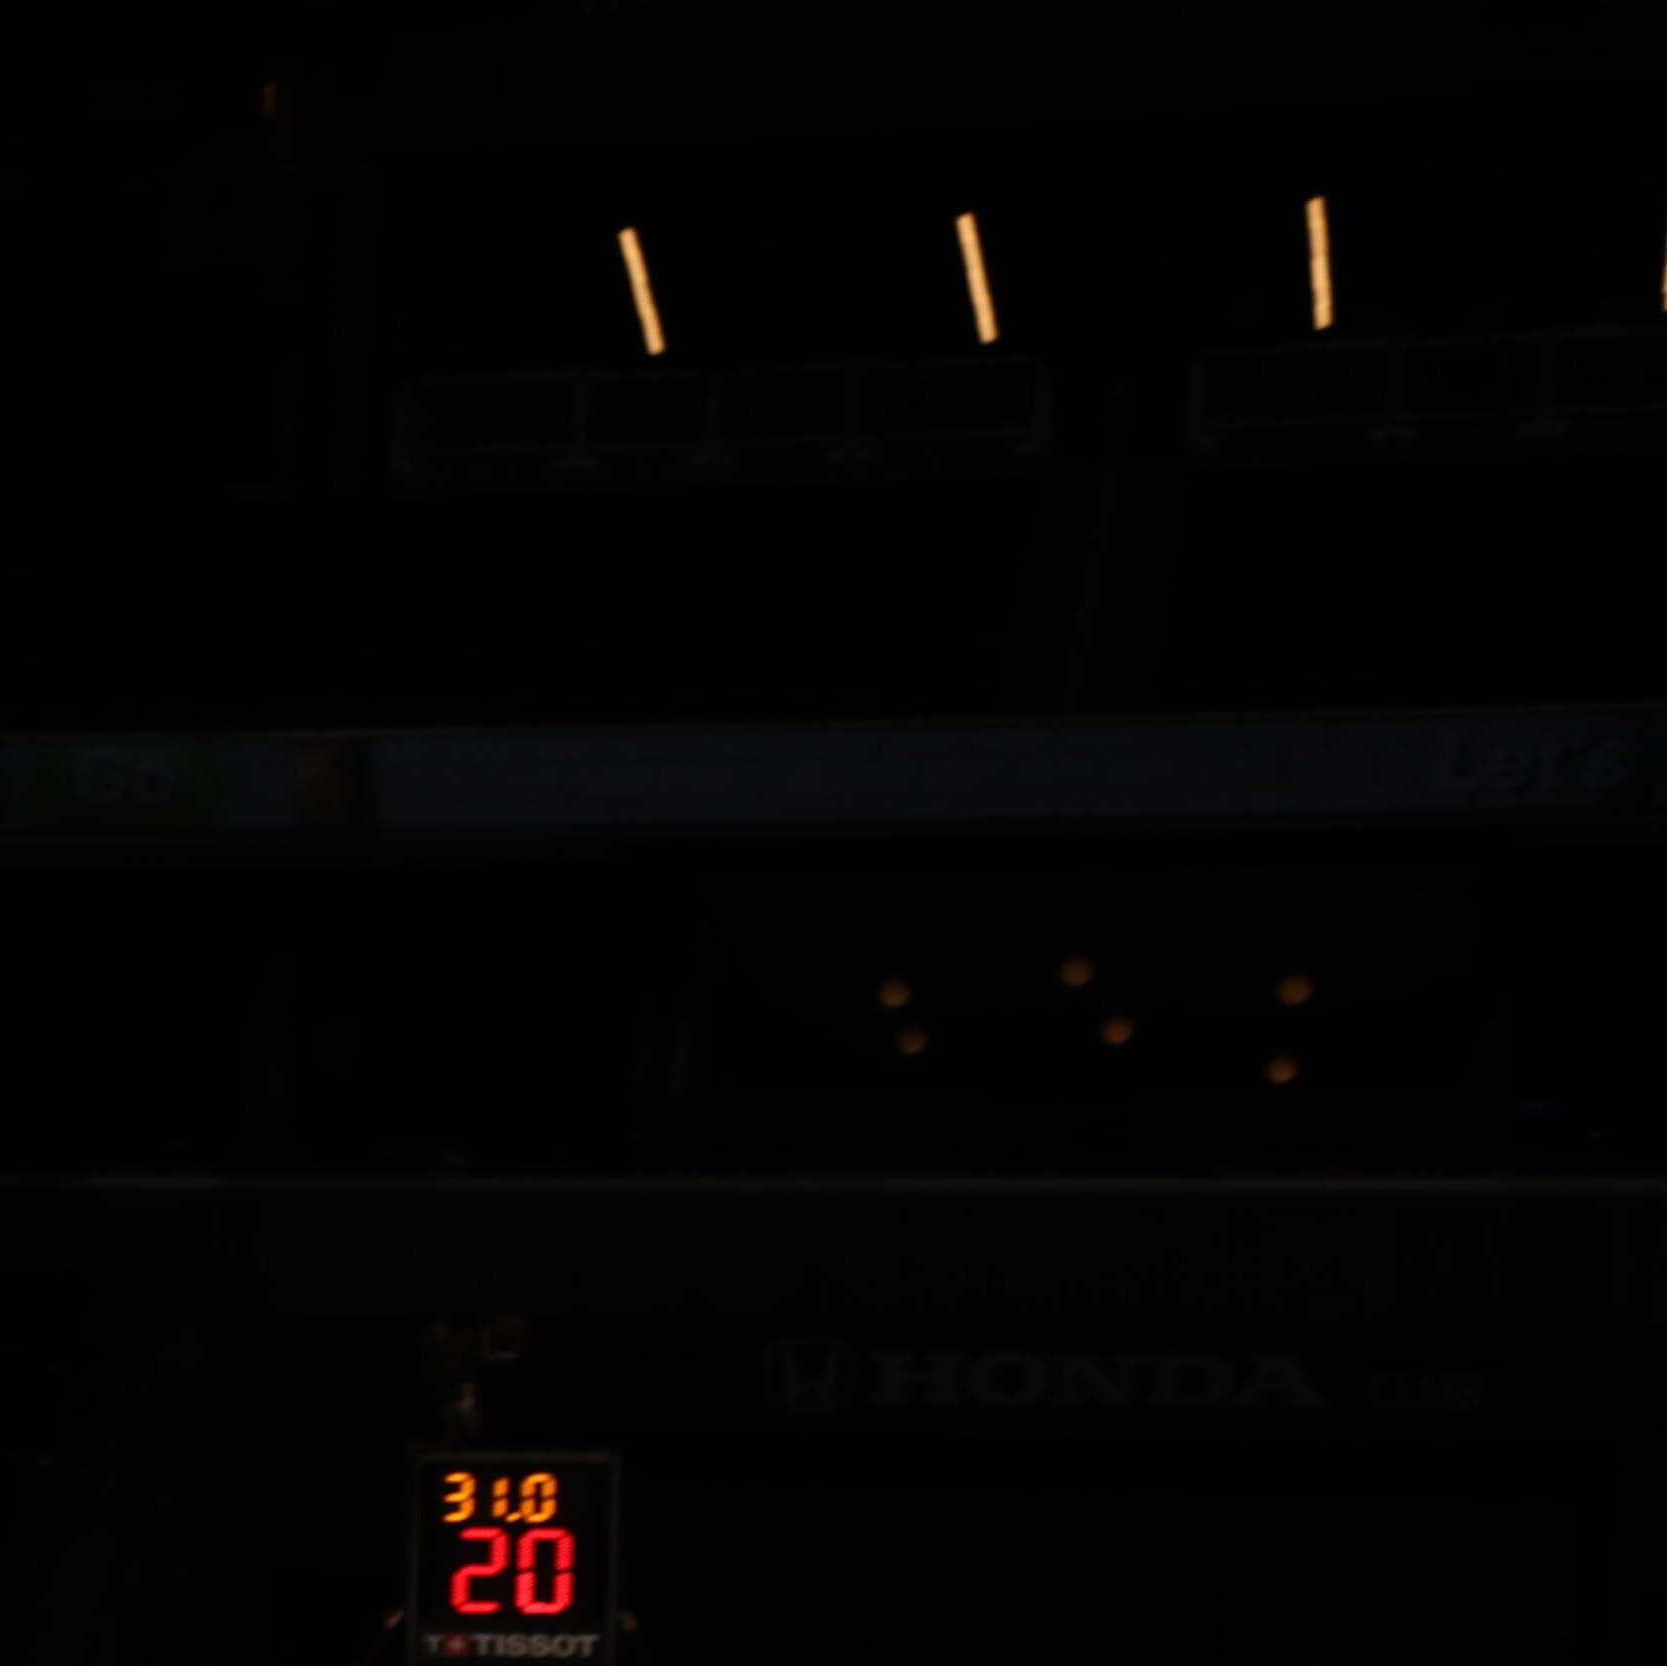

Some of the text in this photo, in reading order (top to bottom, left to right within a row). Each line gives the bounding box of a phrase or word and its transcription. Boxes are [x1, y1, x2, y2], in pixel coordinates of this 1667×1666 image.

[870, 1349, 1331, 1407] HONDA
[440, 1469, 559, 1525] 31.0
[448, 1524, 576, 1616] 20
